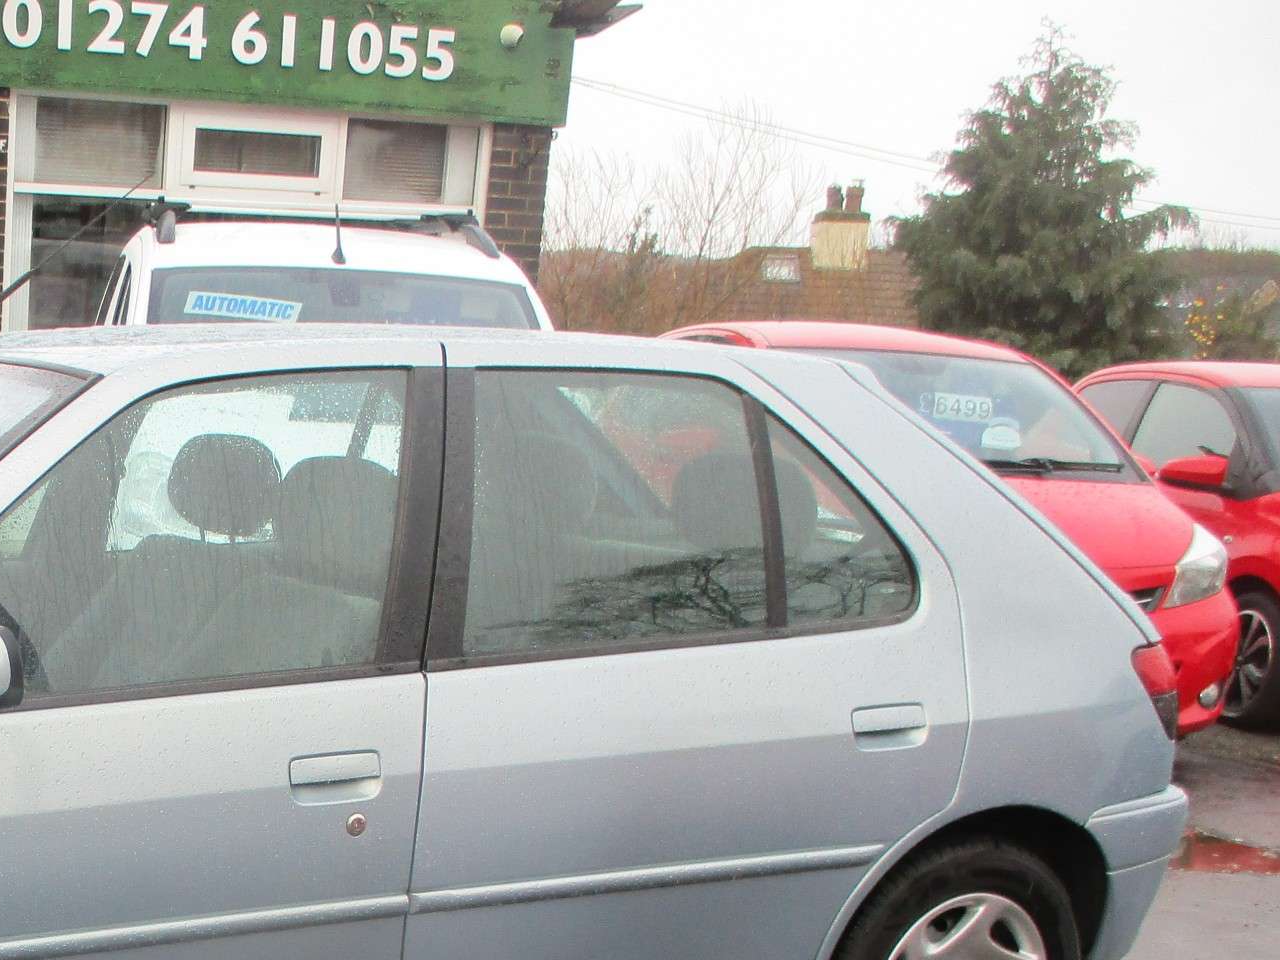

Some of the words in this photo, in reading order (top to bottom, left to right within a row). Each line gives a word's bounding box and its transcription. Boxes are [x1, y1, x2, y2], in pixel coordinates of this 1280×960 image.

[2, 0, 208, 61] 01274
[231, 11, 456, 82] 611055
[192, 295, 295, 319] AUTOMATIC
